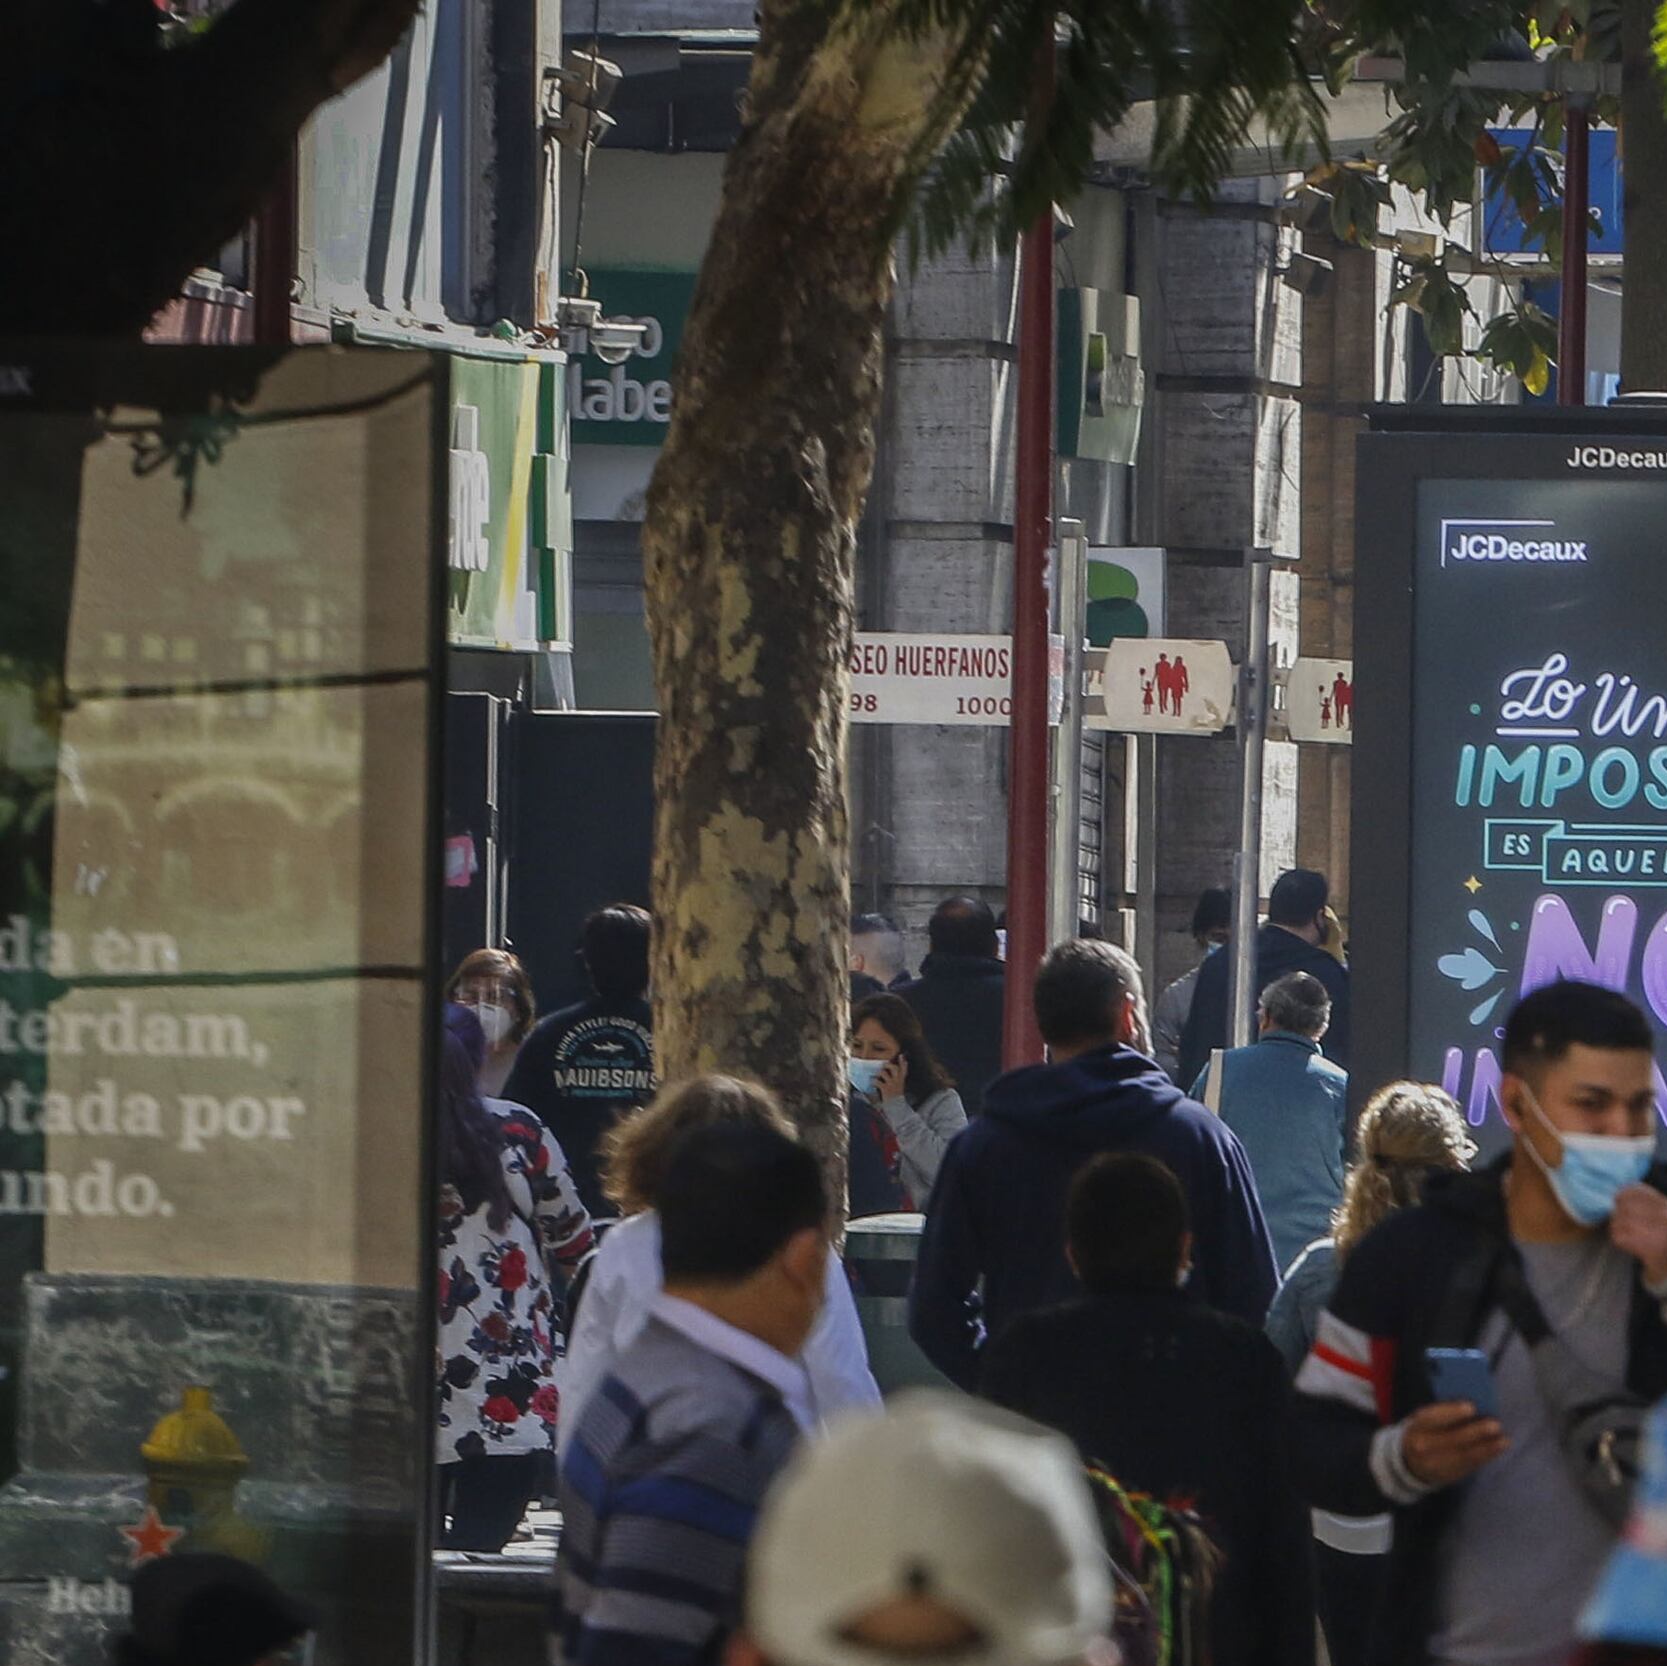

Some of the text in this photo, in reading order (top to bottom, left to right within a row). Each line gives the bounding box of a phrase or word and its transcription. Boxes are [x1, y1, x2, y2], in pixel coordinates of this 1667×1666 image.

[1451, 534, 1588, 562] JCDecaux
[895, 646, 1010, 678] HUERFANOS
[1500, 653, 1587, 720] Lo
[851, 693, 877, 713] 98
[1503, 834, 1531, 856] ES
[91, 927, 180, 974] en
[177, 1092, 306, 1152] por
